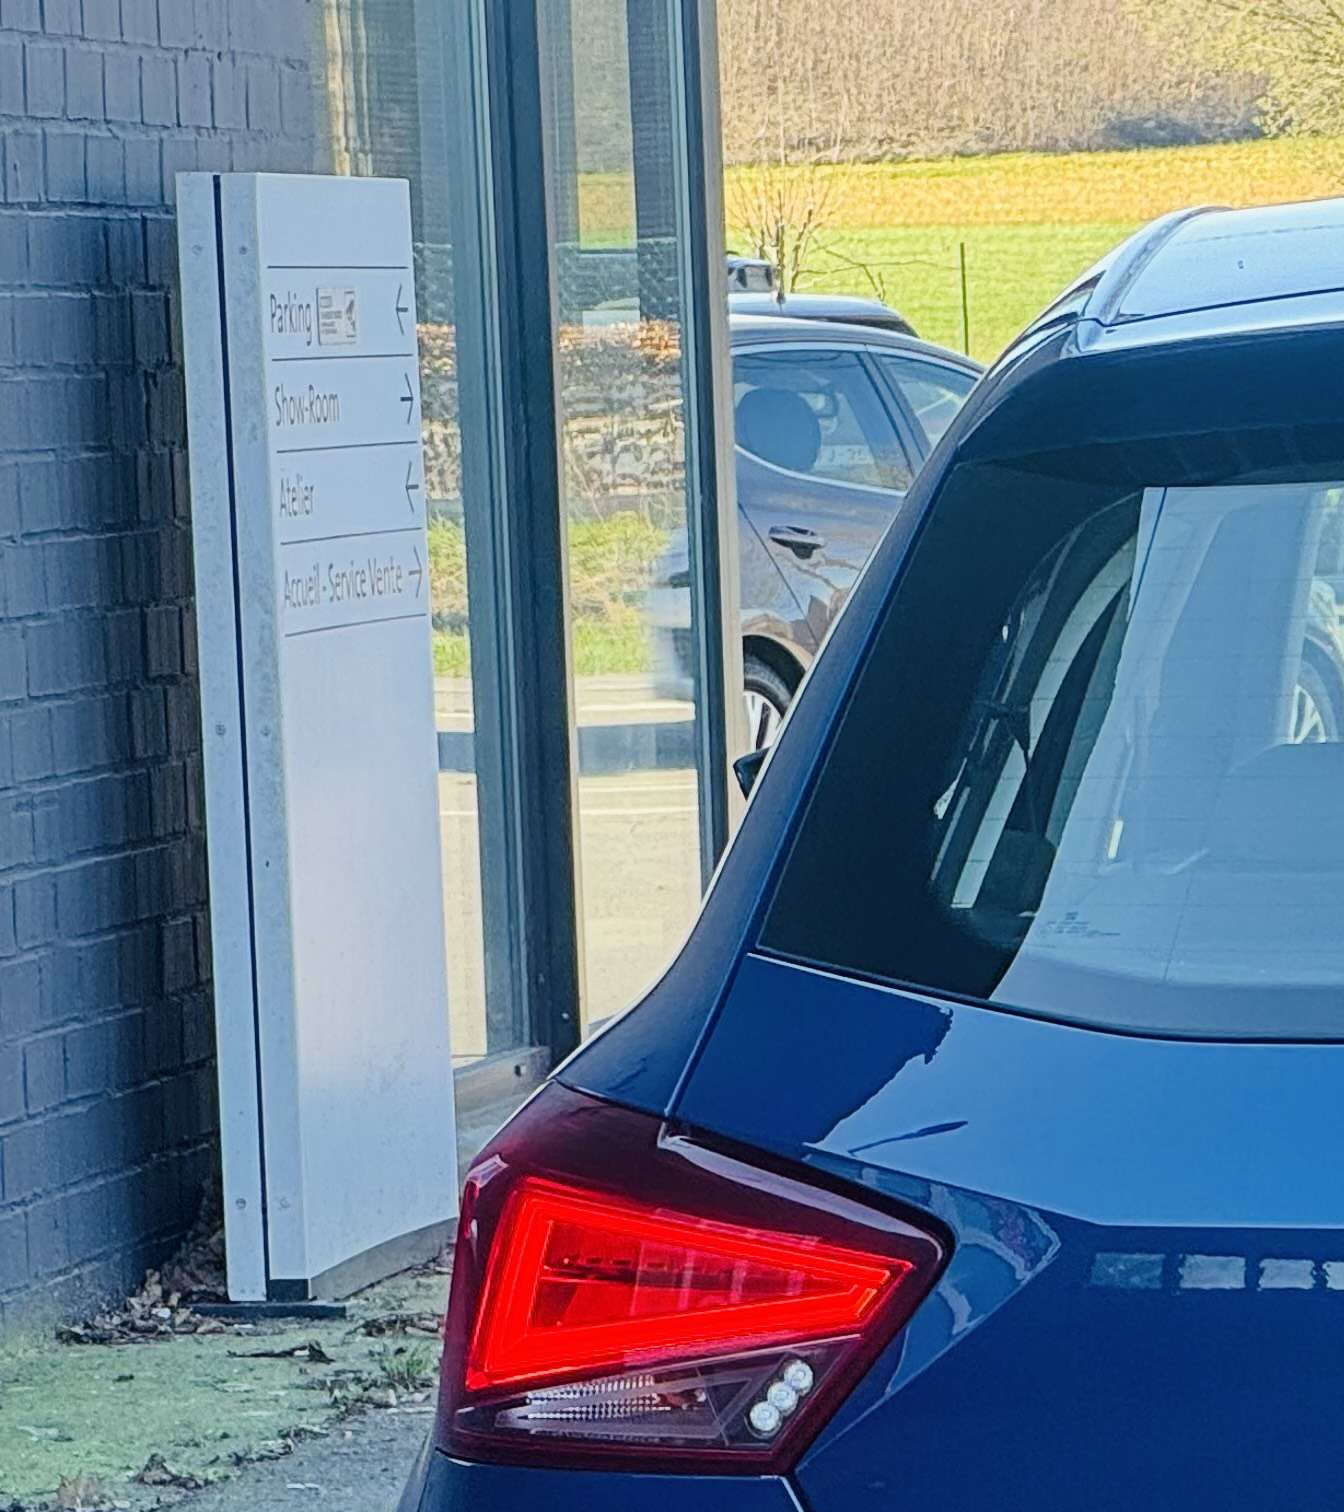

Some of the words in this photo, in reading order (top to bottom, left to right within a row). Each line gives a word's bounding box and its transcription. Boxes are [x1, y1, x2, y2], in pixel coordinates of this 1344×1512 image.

[270, 291, 313, 347] Parking
[274, 383, 341, 427] Show-Room
[280, 473, 315, 518] Atelier
[284, 562, 320, 609] Accueil
[328, 560, 367, 603] Service
[367, 555, 403, 597] Vente
